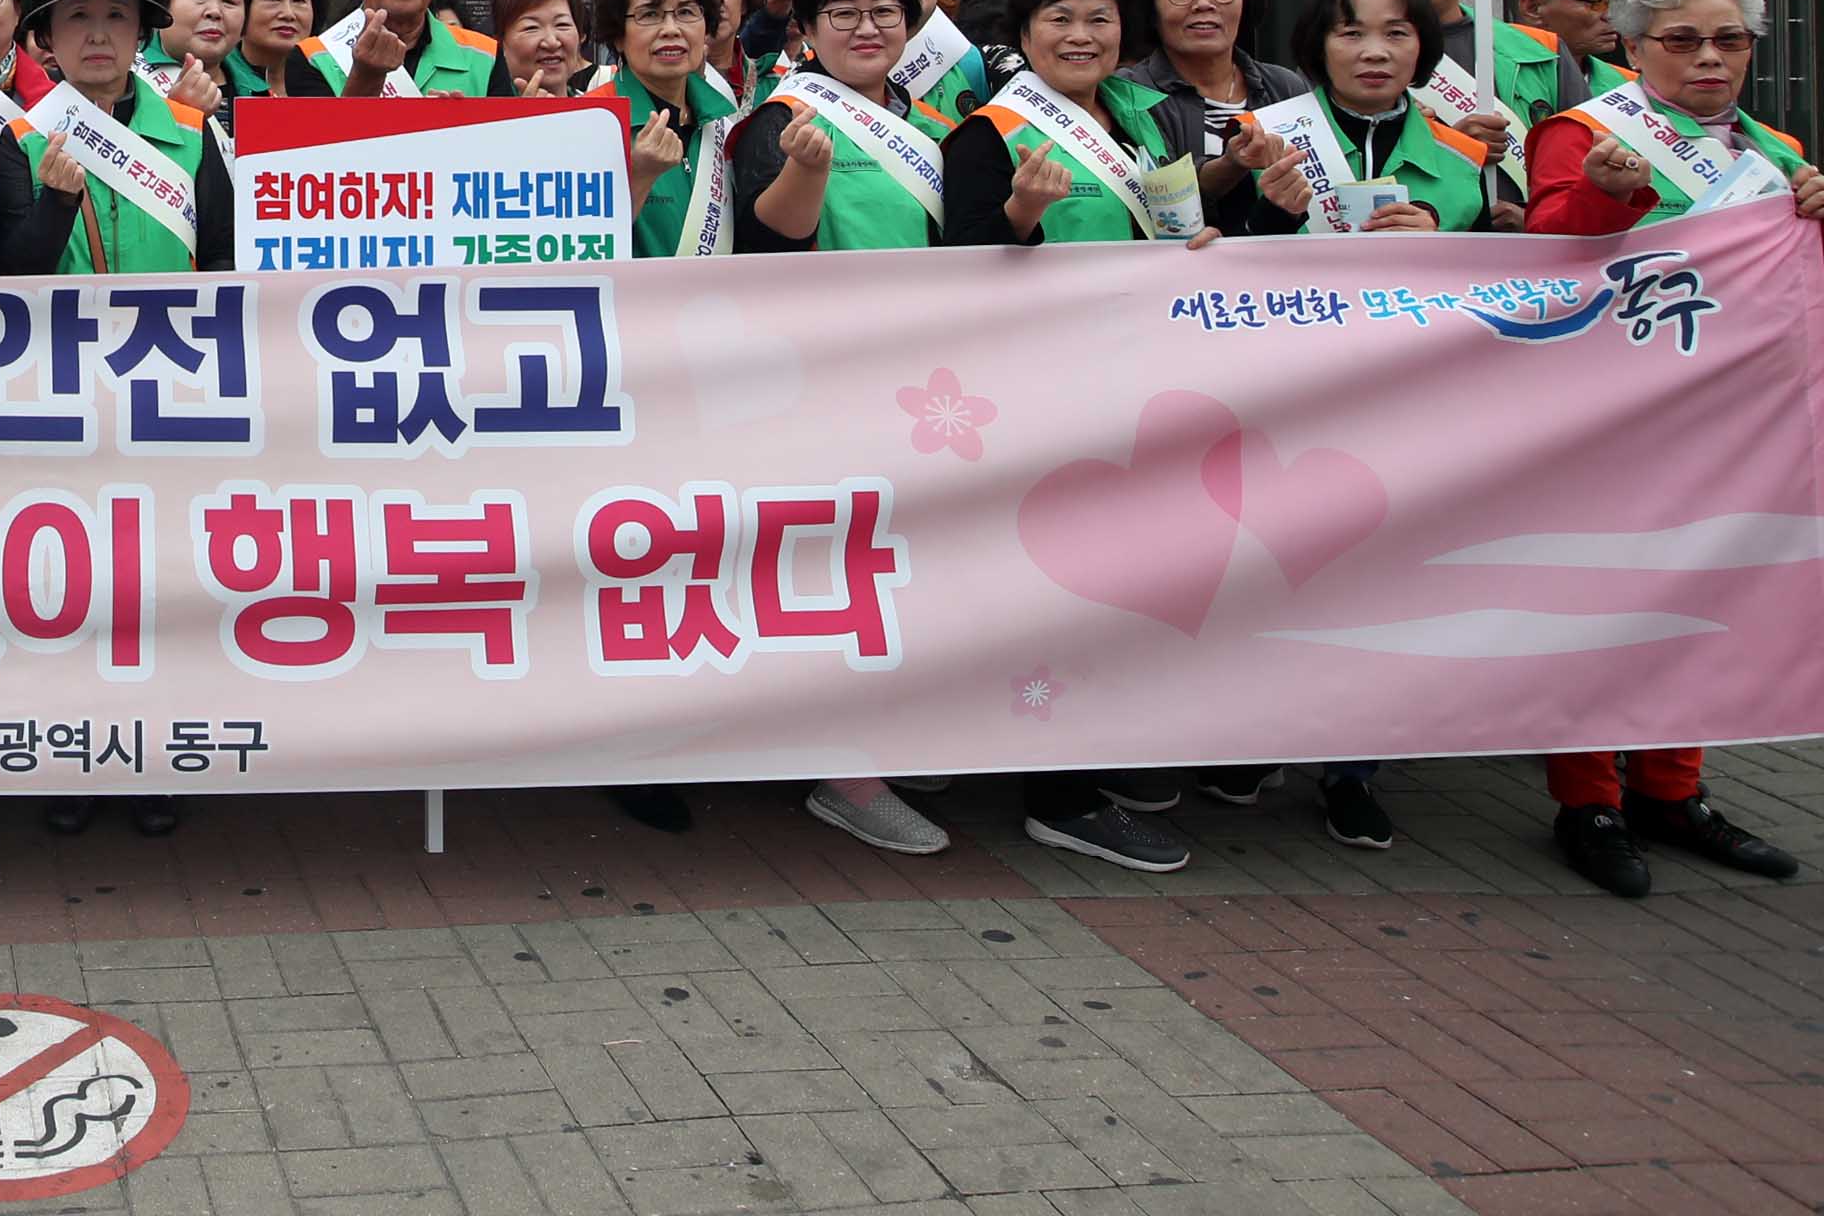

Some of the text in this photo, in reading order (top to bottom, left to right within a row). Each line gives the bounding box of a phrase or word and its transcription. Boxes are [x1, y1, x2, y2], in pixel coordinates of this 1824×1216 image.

[254, 170, 433, 220] 참여하자!
[452, 170, 614, 220] 재난대비
[1606, 251, 1721, 353] 동구
[310, 283, 622, 445] 없고
[203, 492, 527, 666] 행복
[586, 489, 896, 661] 없다
[163, 717, 269, 771] 동구
